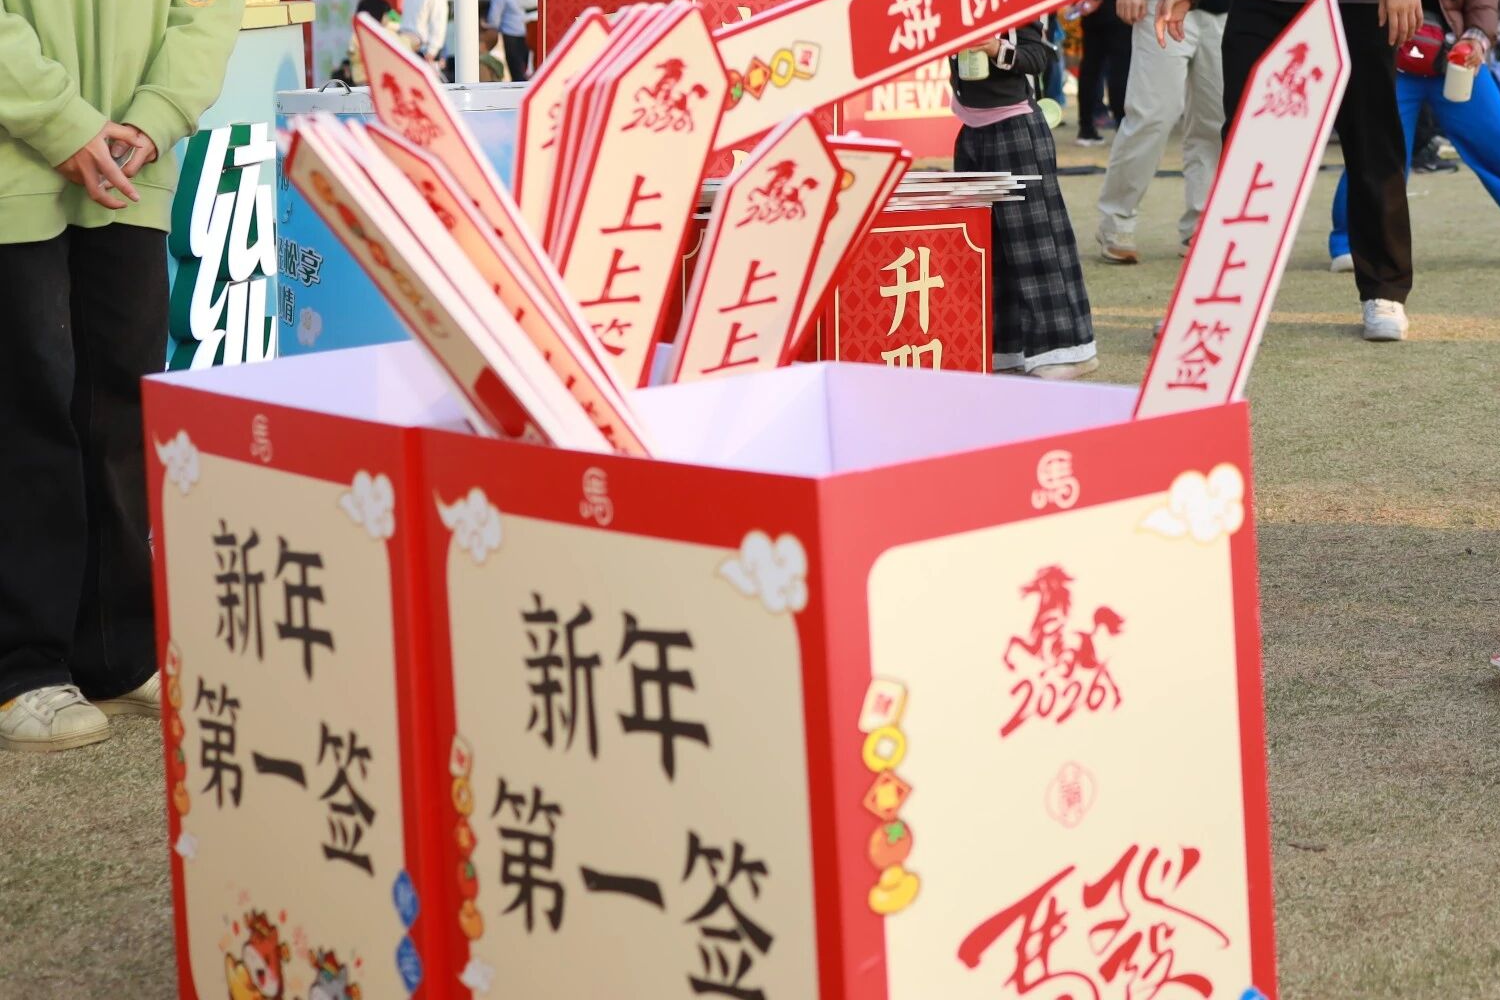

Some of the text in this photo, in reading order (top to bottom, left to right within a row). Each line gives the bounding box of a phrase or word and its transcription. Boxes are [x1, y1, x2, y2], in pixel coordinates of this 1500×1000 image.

[1166, 161, 1274, 392] 上上签
[212, 518, 336, 680] 新年
[519, 590, 713, 784] 新年
[192, 675, 379, 878] 第一签
[998, 666, 1107, 740] 2026
[490, 775, 778, 1000] 第一签
